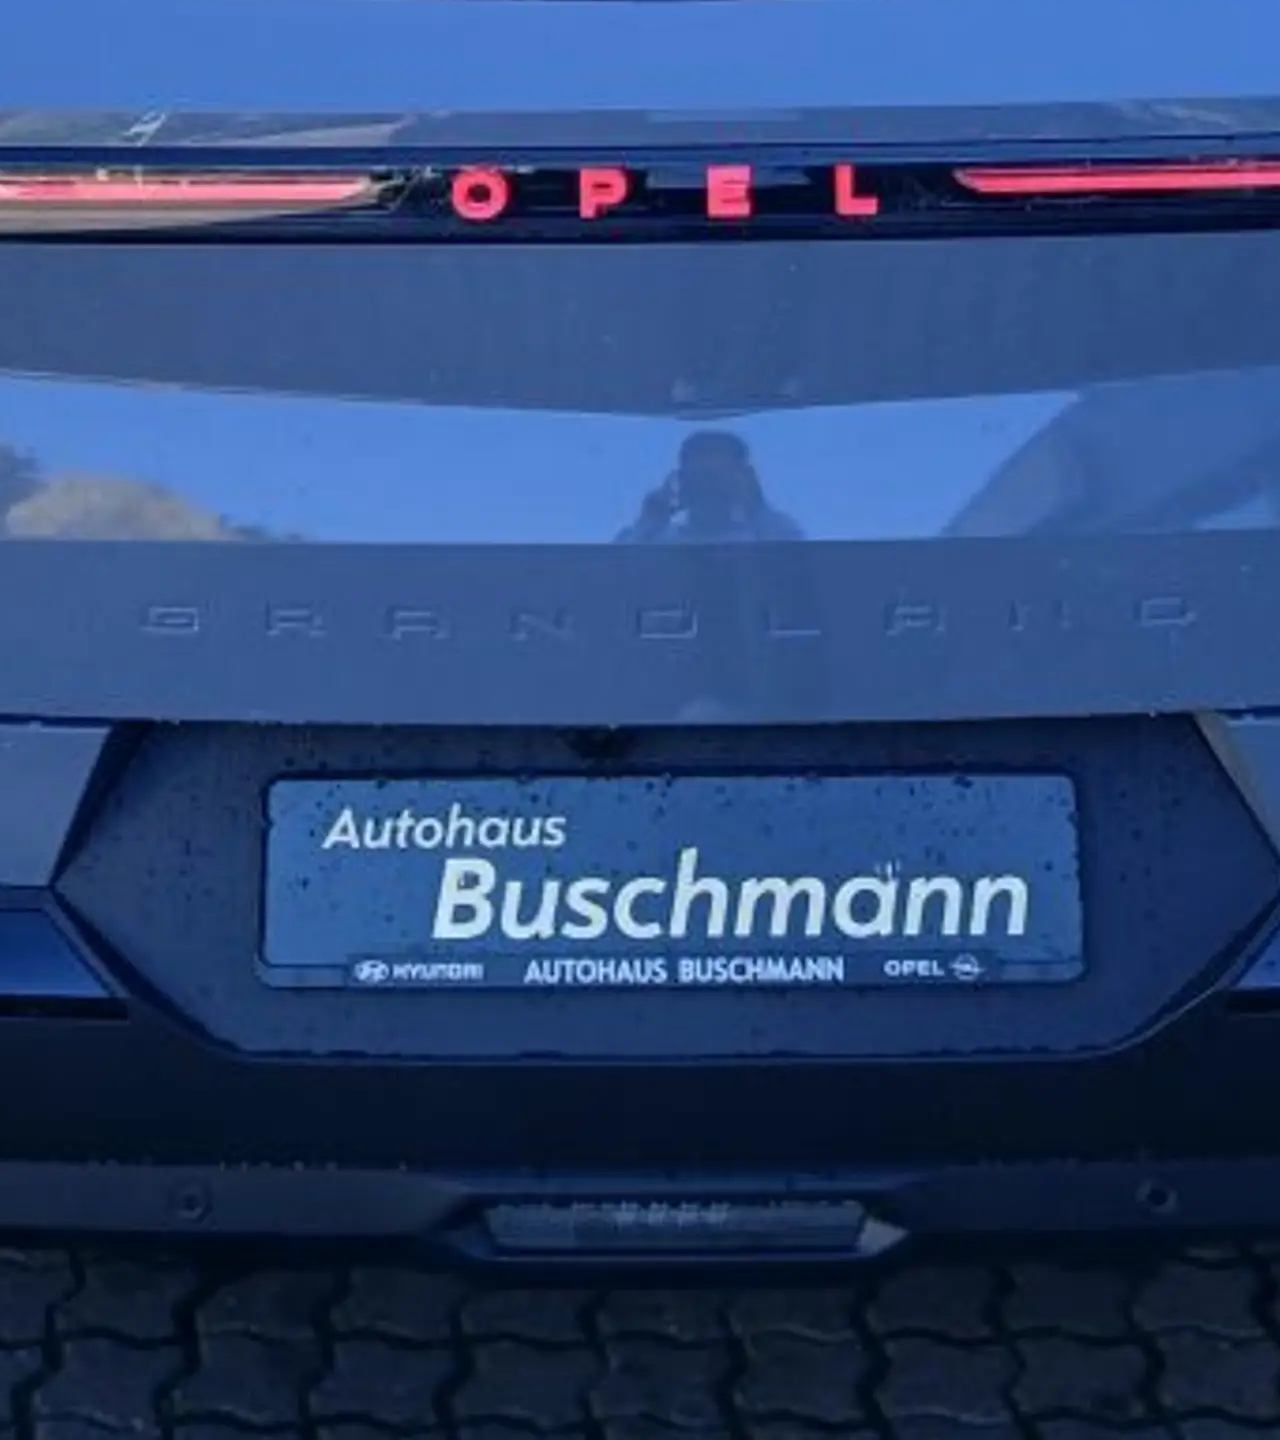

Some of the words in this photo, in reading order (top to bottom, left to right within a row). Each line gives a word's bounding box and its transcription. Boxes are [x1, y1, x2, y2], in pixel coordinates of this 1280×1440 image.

[451, 163, 879, 220] OPEL
[322, 802, 566, 850] Autohaus
[432, 847, 1029, 939] Buschmann
[523, 959, 667, 984] AUTOHAUS
[678, 957, 845, 983] BUSCHMANN
[883, 960, 946, 977] OPEL
